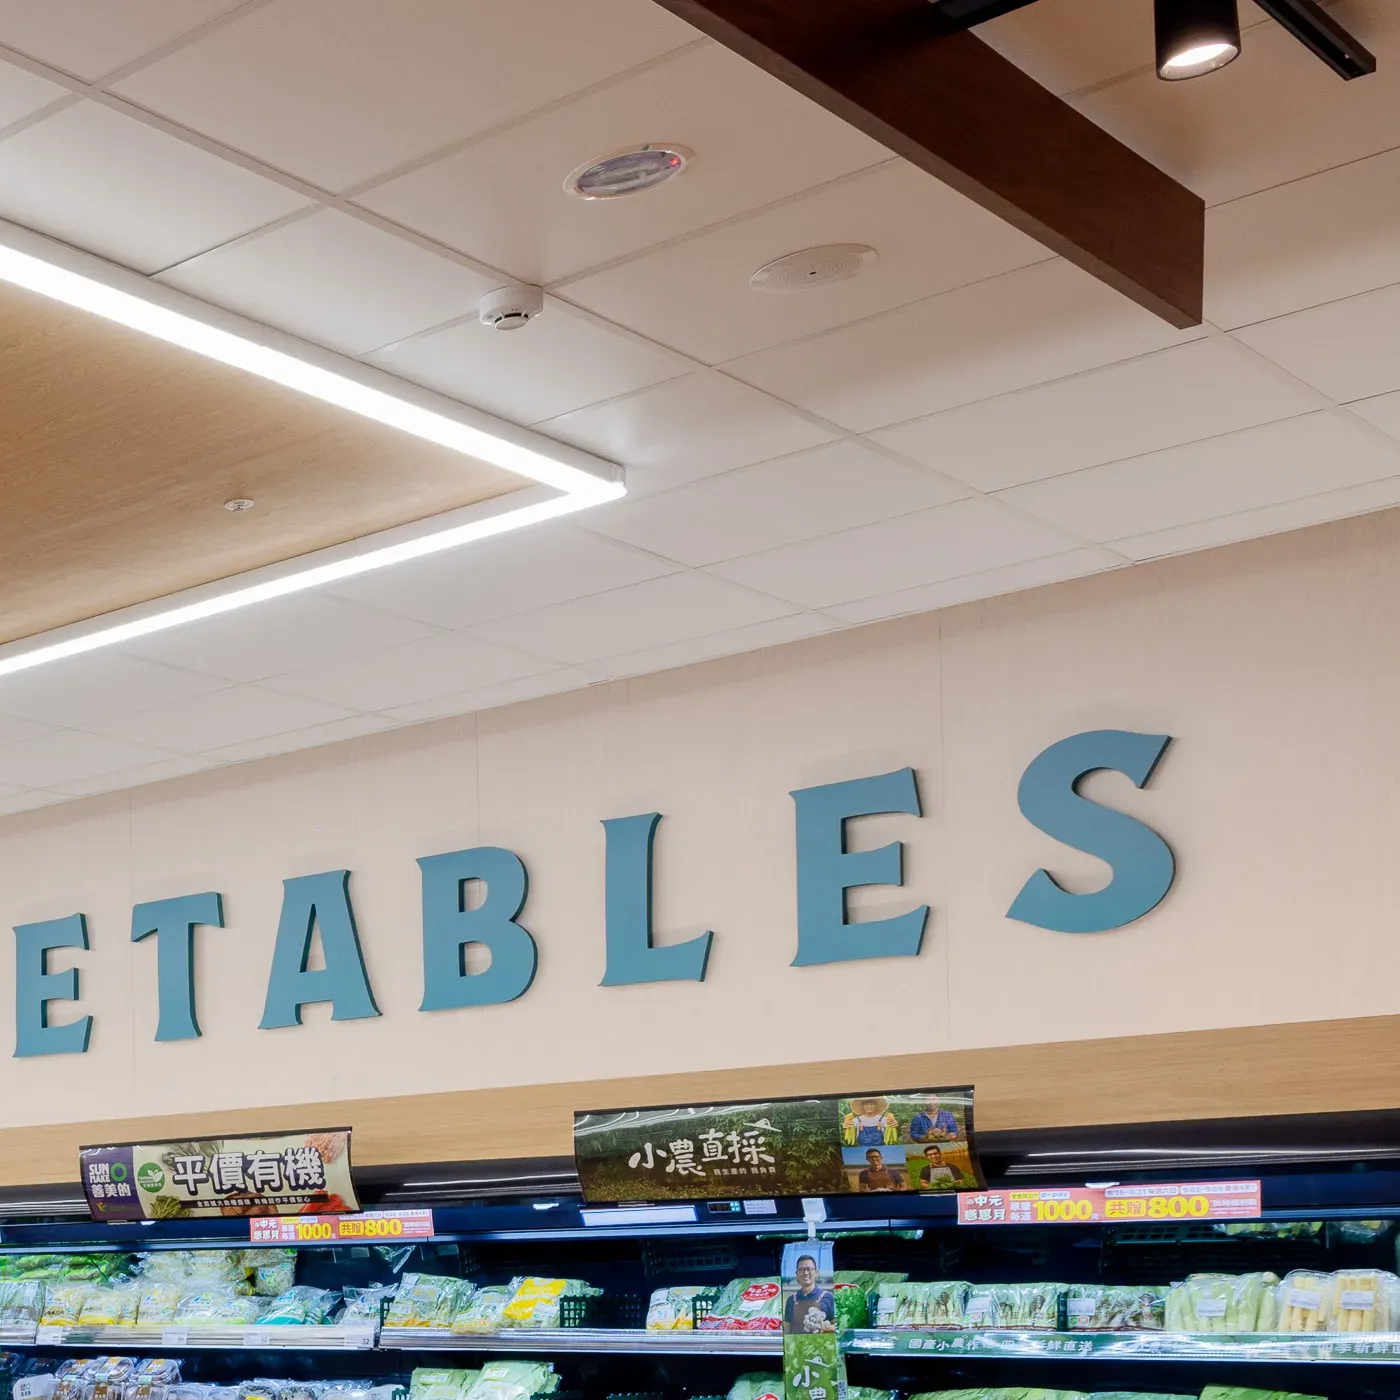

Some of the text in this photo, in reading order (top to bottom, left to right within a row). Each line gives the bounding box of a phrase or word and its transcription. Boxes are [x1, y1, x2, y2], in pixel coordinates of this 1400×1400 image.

[627, 1128, 776, 1177] 小農直採
[88, 1163, 110, 1175] SUN
[89, 1174, 111, 1183] MAKE
[173, 1147, 325, 1194] 平價有機
[91, 1183, 131, 1199] 善美的
[1147, 1195, 1210, 1218] 800
[364, 1217, 403, 1236] 800
